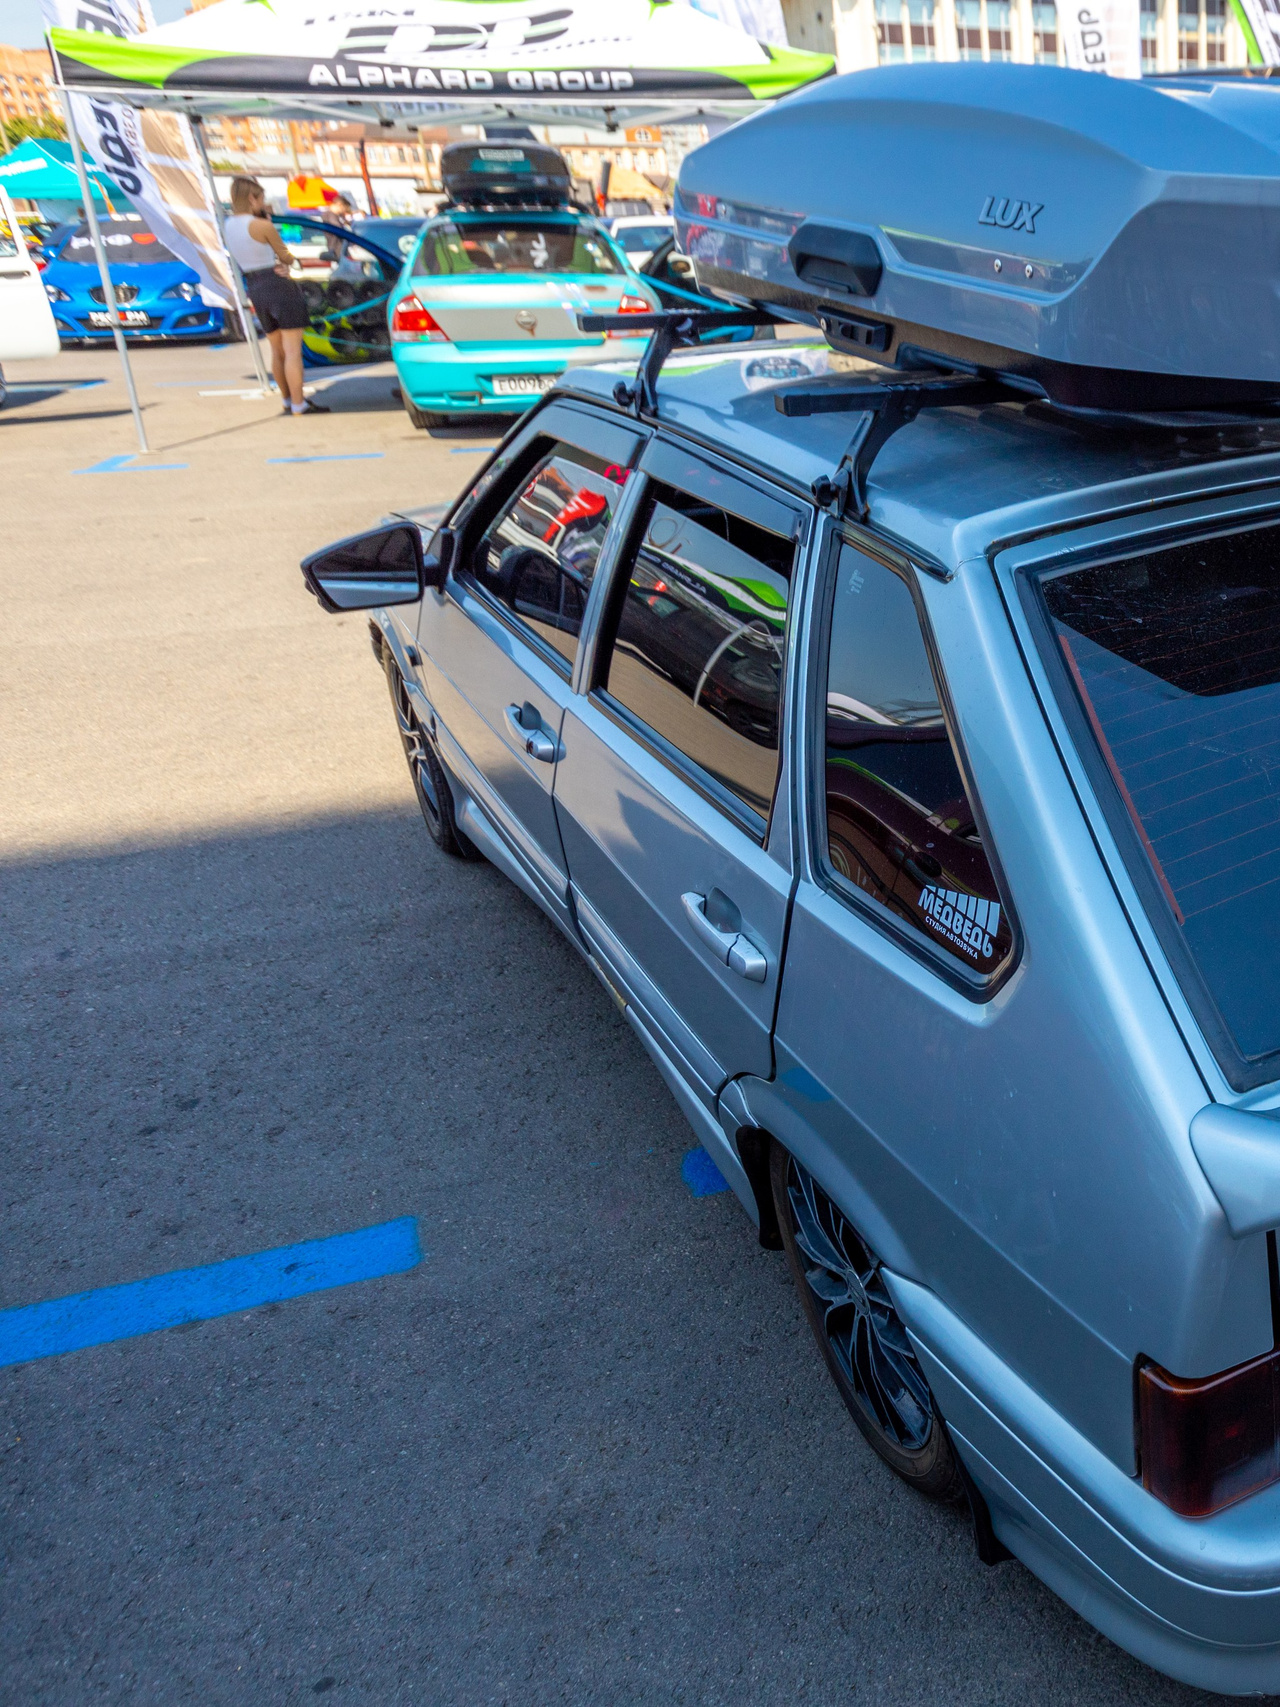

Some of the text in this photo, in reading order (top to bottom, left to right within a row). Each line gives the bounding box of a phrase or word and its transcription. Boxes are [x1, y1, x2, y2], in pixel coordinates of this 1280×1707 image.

[308, 64, 634, 91] ALPHARD GROUP
[978, 196, 1044, 233] LUX
[918, 888, 993, 958] МЕДВЕДЬ
[925, 915, 978, 960] СТУДИЯ АВТОЗВУКА
